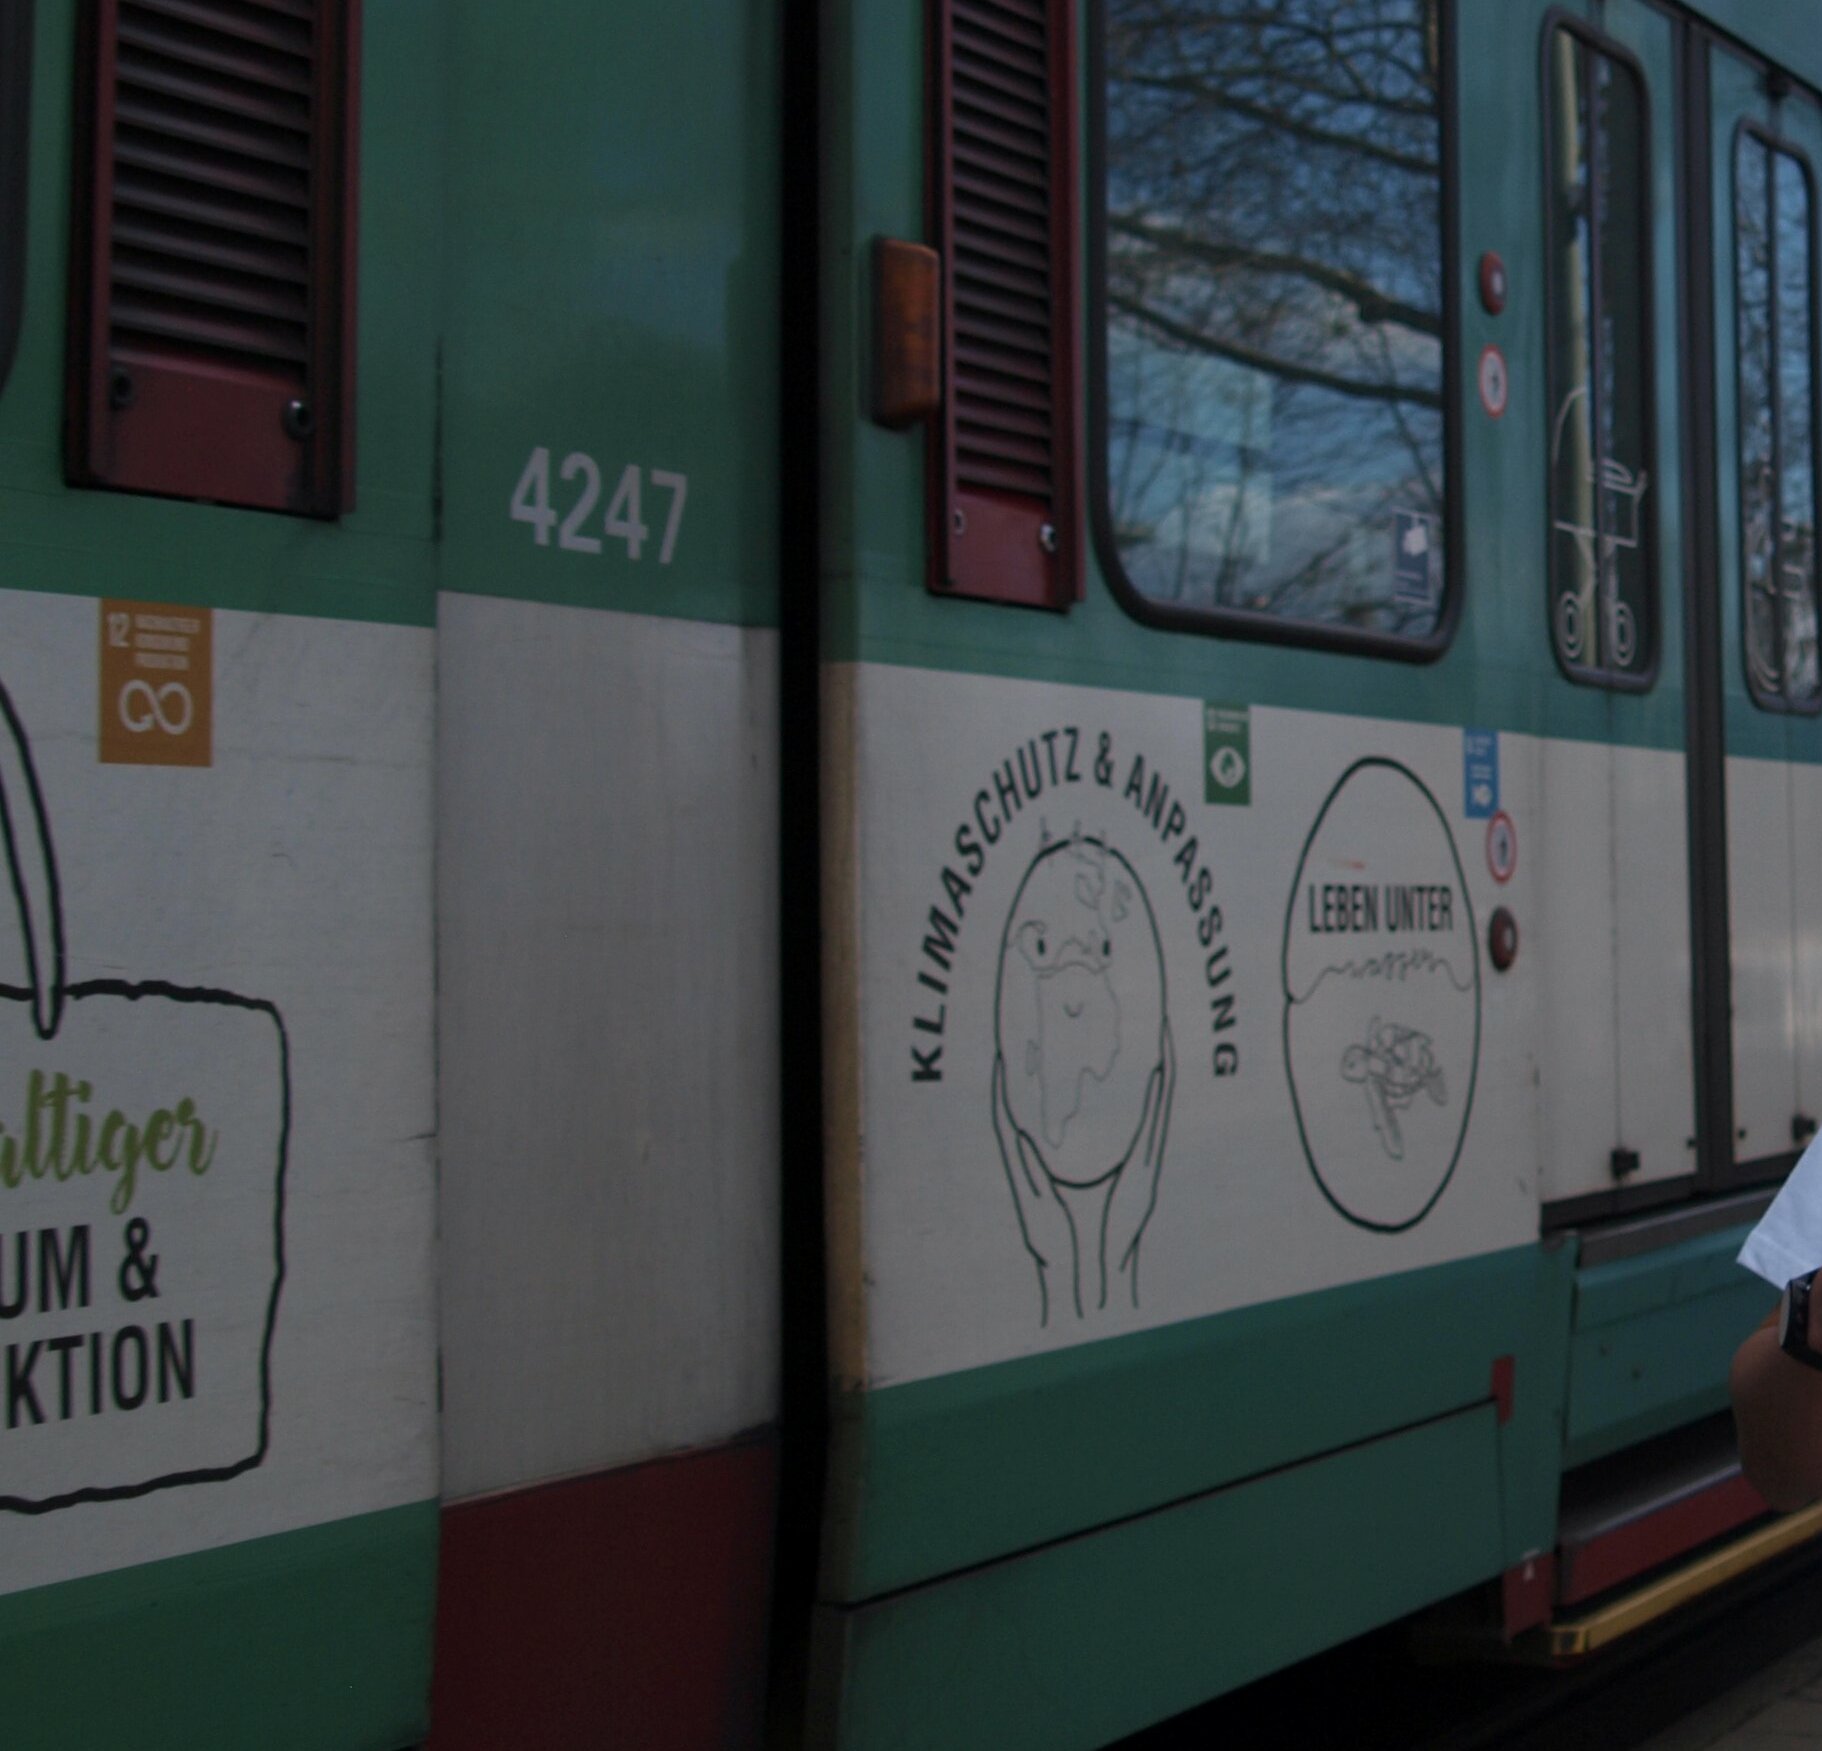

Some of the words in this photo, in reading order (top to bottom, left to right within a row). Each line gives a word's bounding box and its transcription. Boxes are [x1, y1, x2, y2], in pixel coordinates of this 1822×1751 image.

[510, 446, 687, 565] 4247
[911, 727, 1081, 1082] KLIMASCHUTZ
[1094, 731, 1114, 788] &
[1124, 753, 1239, 1077] ANPASSUNG
[1308, 883, 1378, 933] LEBEN
[1385, 883, 1453, 932] UNTER
[0, 1223, 90, 1319] UM
[117, 1216, 160, 1302] &
[6, 1318, 194, 1429] KTION
